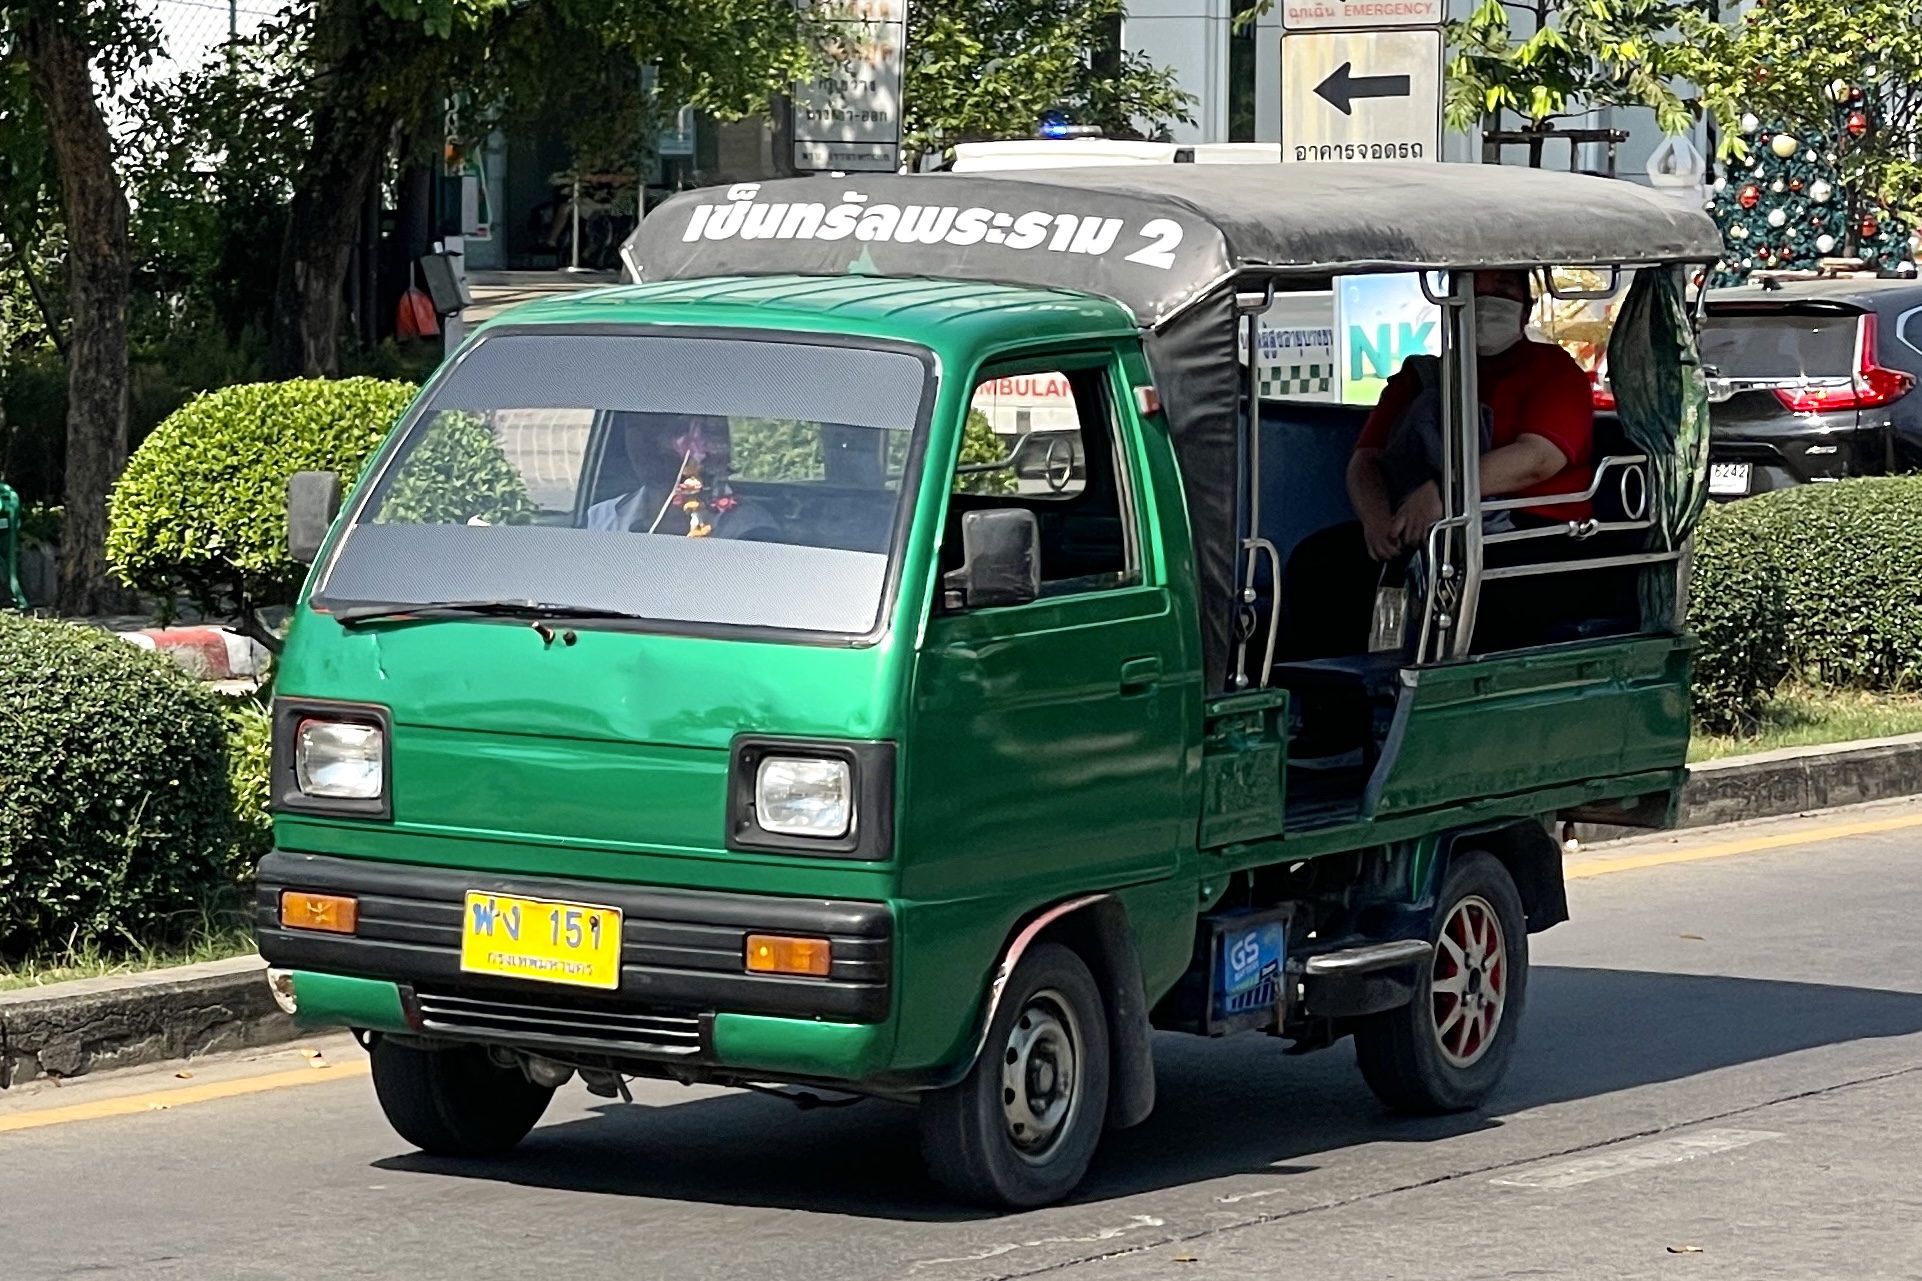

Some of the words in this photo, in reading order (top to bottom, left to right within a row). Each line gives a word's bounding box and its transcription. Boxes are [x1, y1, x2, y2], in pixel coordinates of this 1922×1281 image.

[1289, 3, 1336, 24] ฉุกเฉิน
[1344, 3, 1433, 16] EMERGENCY
[1295, 142, 1423, 161] อาคารจอดรถ
[682, 183, 1124, 256] เซ็นทรัลพระราม
[1124, 219, 1184, 270] 2
[550, 909, 601, 950] 151
[1231, 932, 1260, 971] GS
